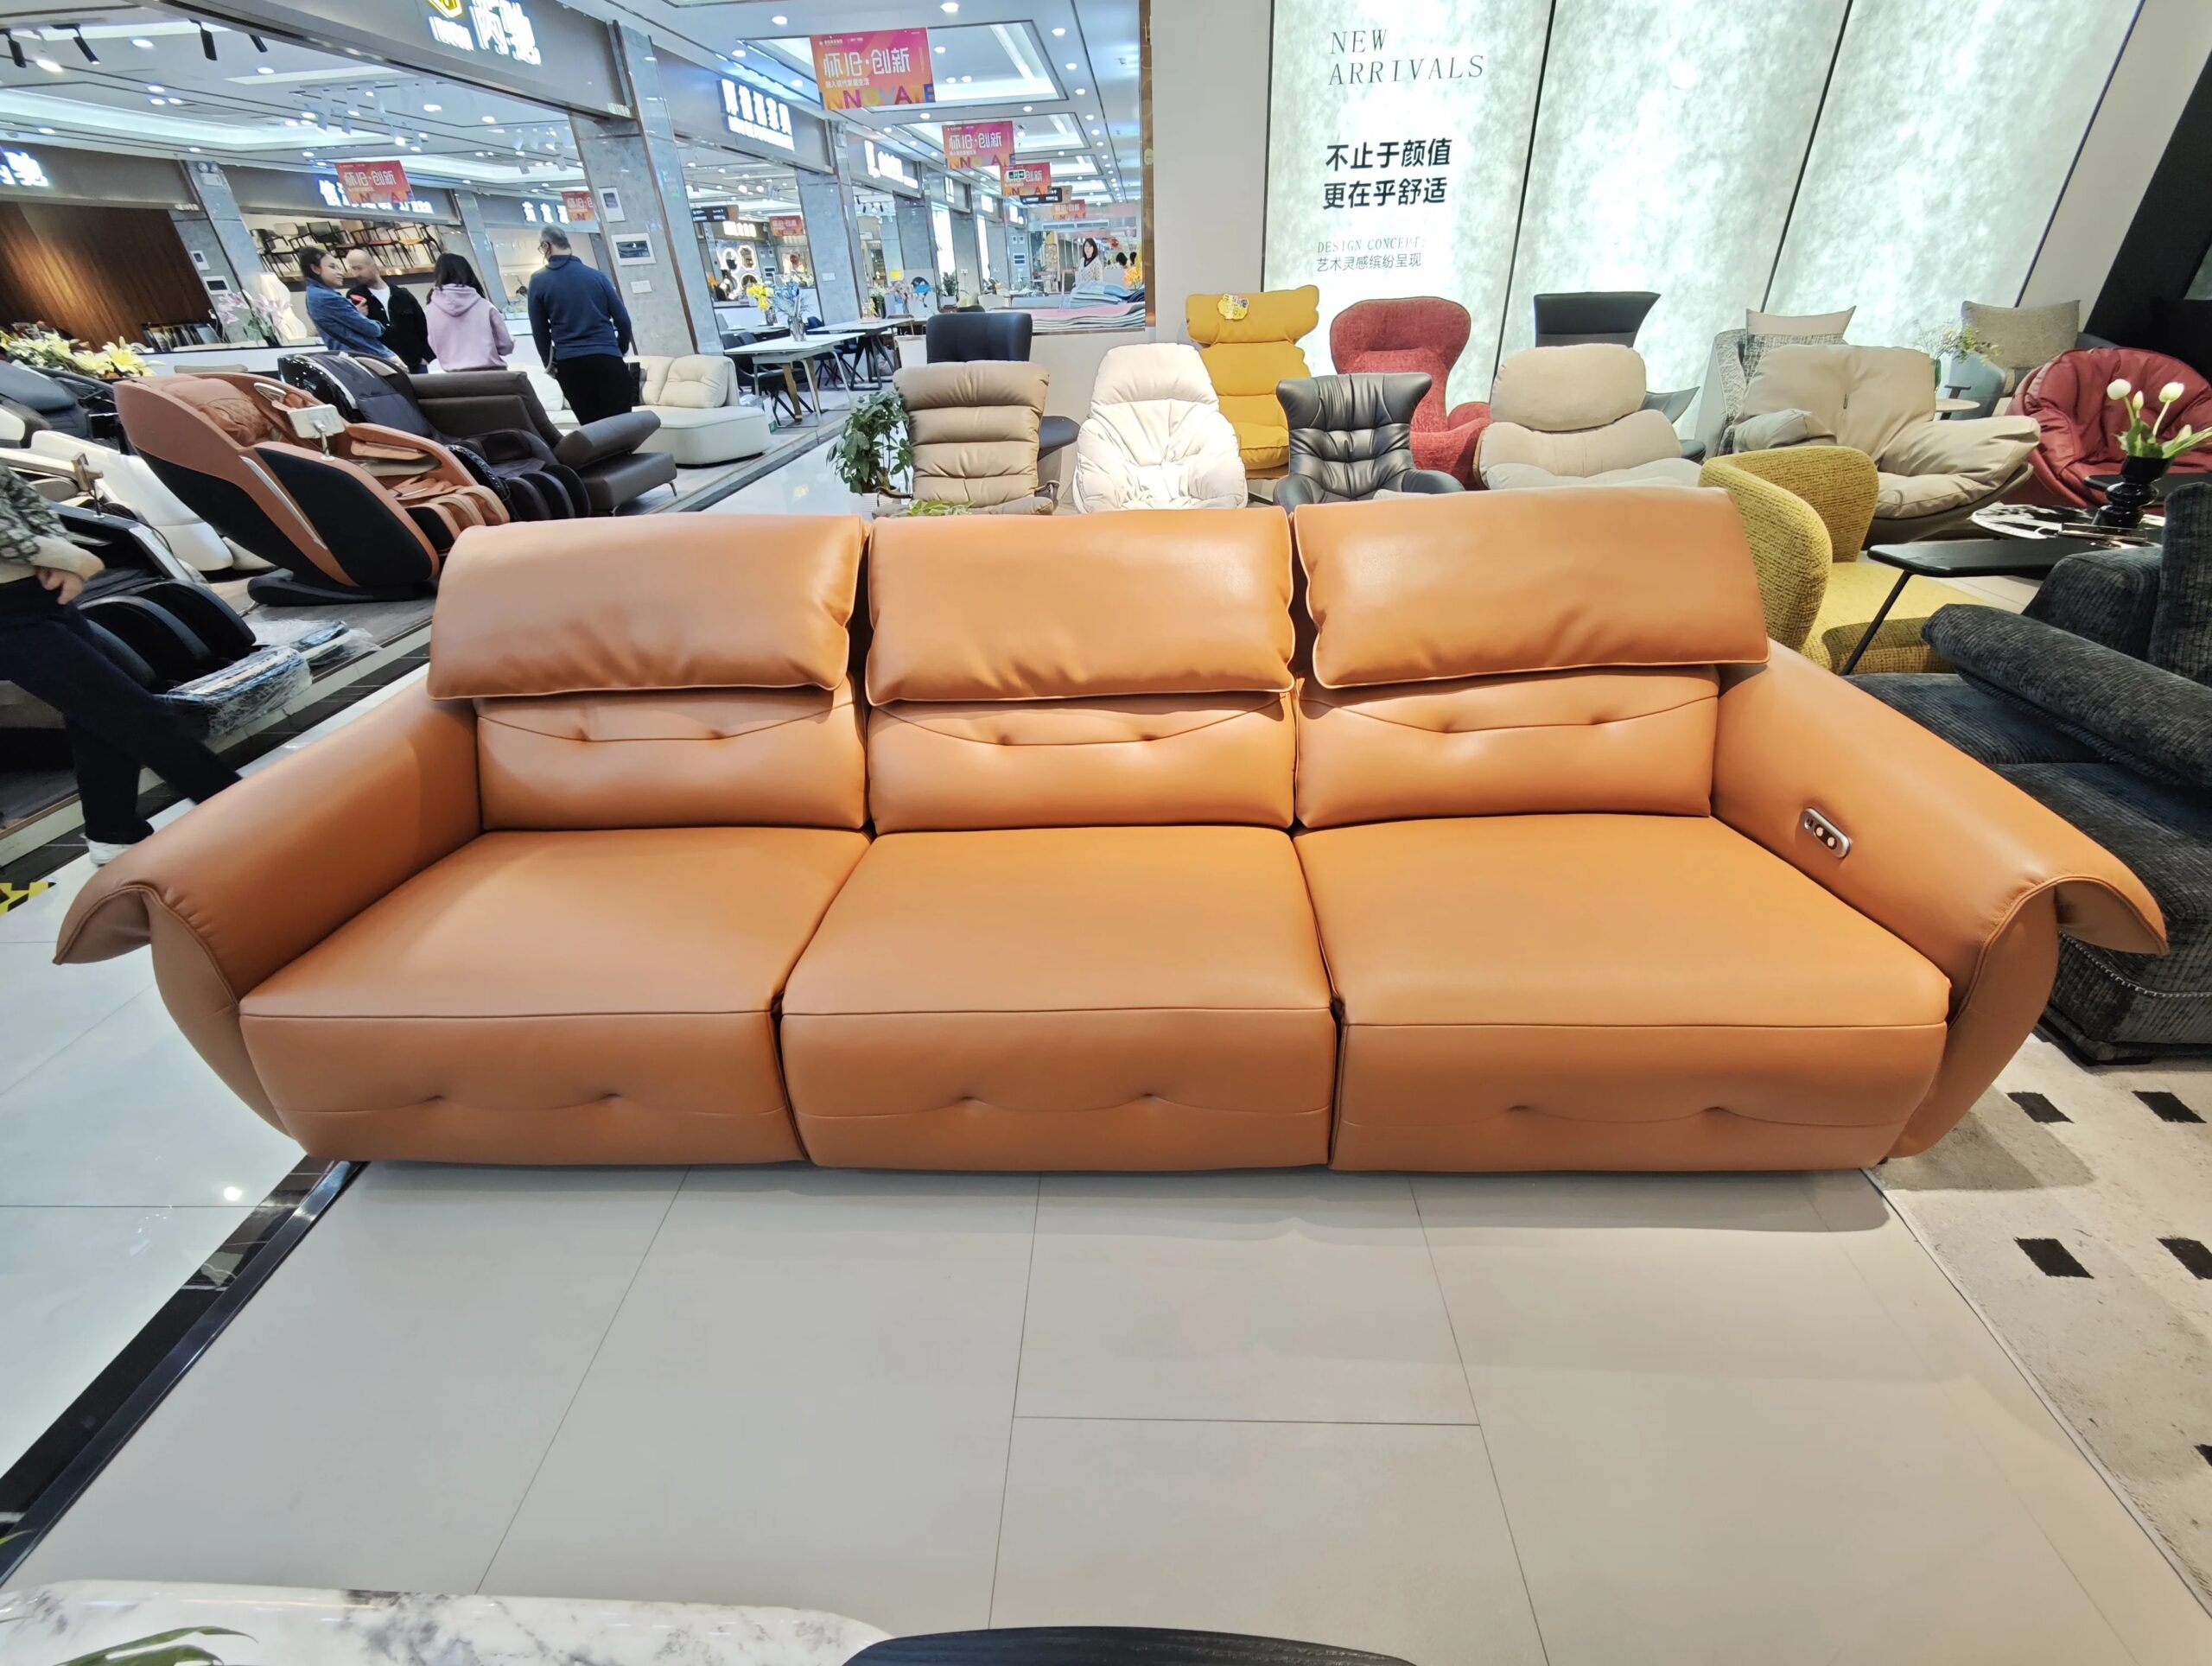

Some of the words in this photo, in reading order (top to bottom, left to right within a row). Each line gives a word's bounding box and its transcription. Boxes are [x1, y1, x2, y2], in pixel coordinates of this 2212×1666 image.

[1329, 29, 1388, 54] NEW
[1327, 54, 1484, 86] ARRIVALS
[1325, 137, 1452, 172] 不止于颜值
[1323, 177, 1448, 210] 更在乎舒适
[1317, 238, 1363, 254] DESIGN
[1317, 252, 1422, 272] 艺术灵感缤纷呈现
